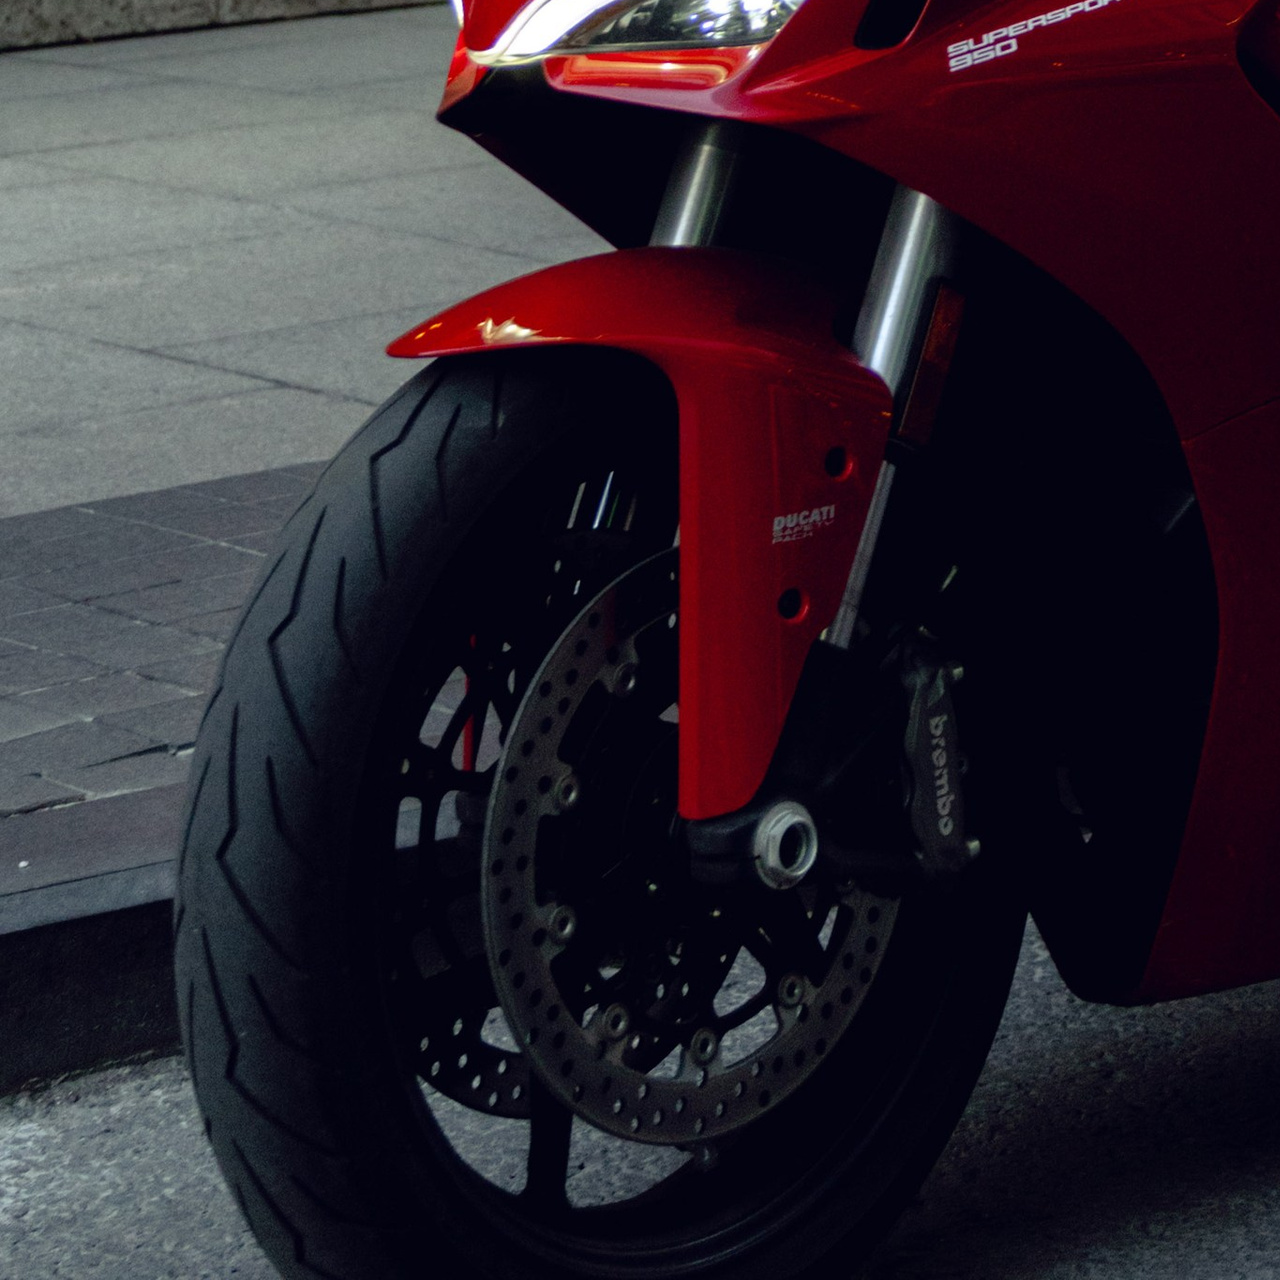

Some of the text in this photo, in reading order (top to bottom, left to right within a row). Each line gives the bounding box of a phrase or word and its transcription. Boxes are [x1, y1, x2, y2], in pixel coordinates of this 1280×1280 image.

[948, 37, 1019, 73] 950
[773, 504, 835, 532] DUCATI
[928, 713, 956, 836] brembo
